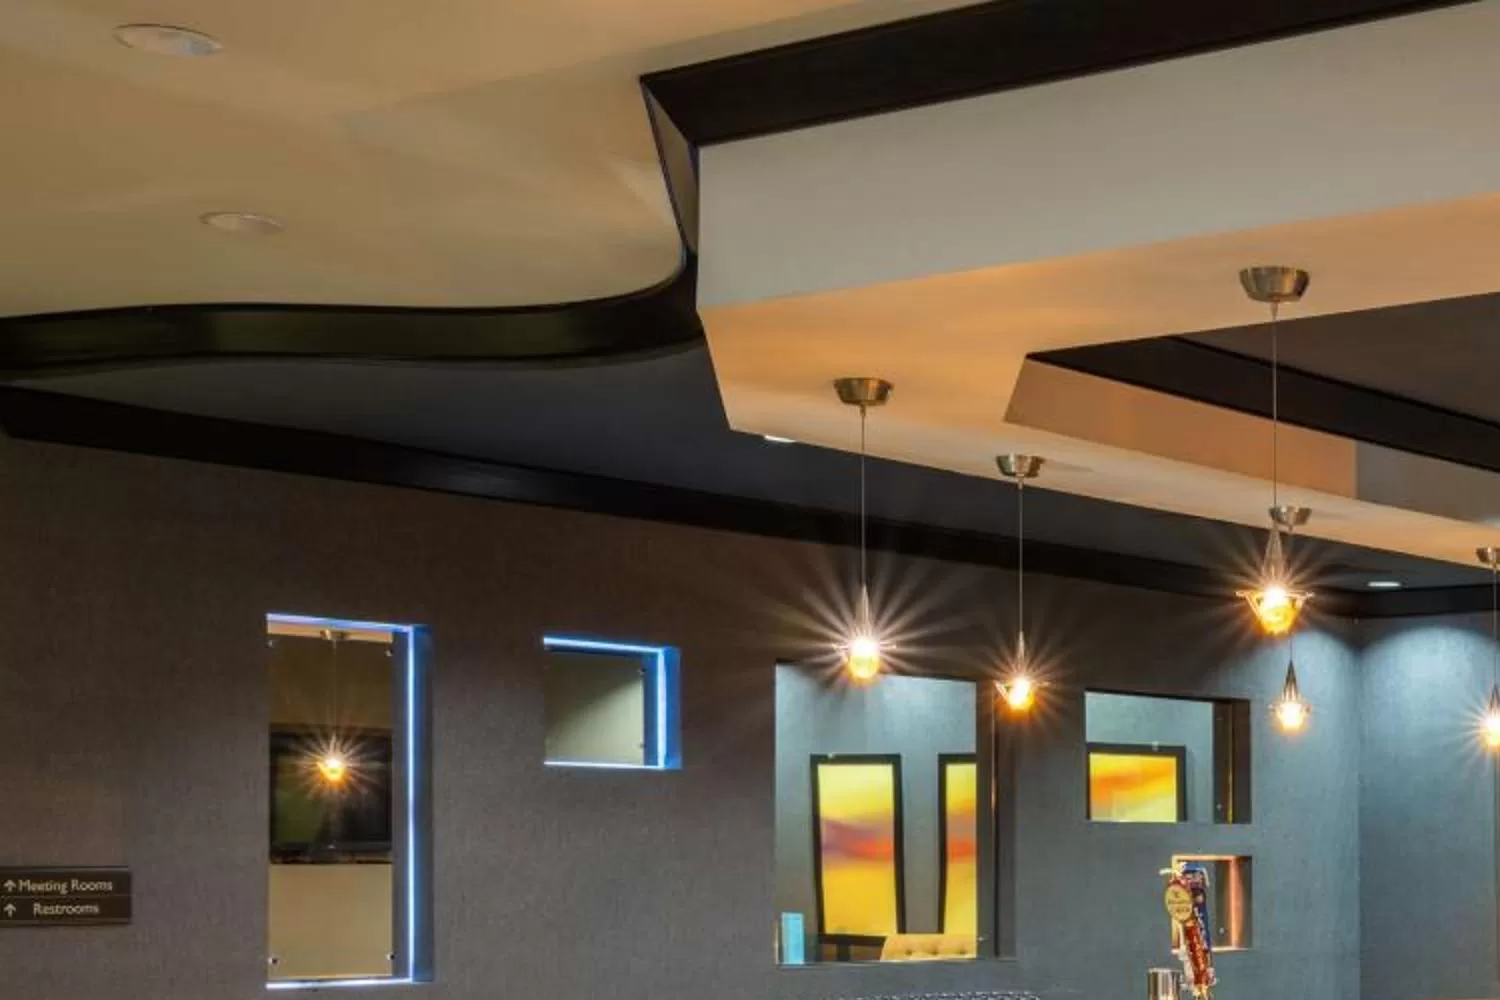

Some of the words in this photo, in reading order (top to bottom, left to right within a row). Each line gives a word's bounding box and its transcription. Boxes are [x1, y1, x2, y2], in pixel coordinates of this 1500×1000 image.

[18, 879, 68, 895] Meeting
[71, 879, 113, 892] Rooms
[33, 902, 100, 917] Restrooms
